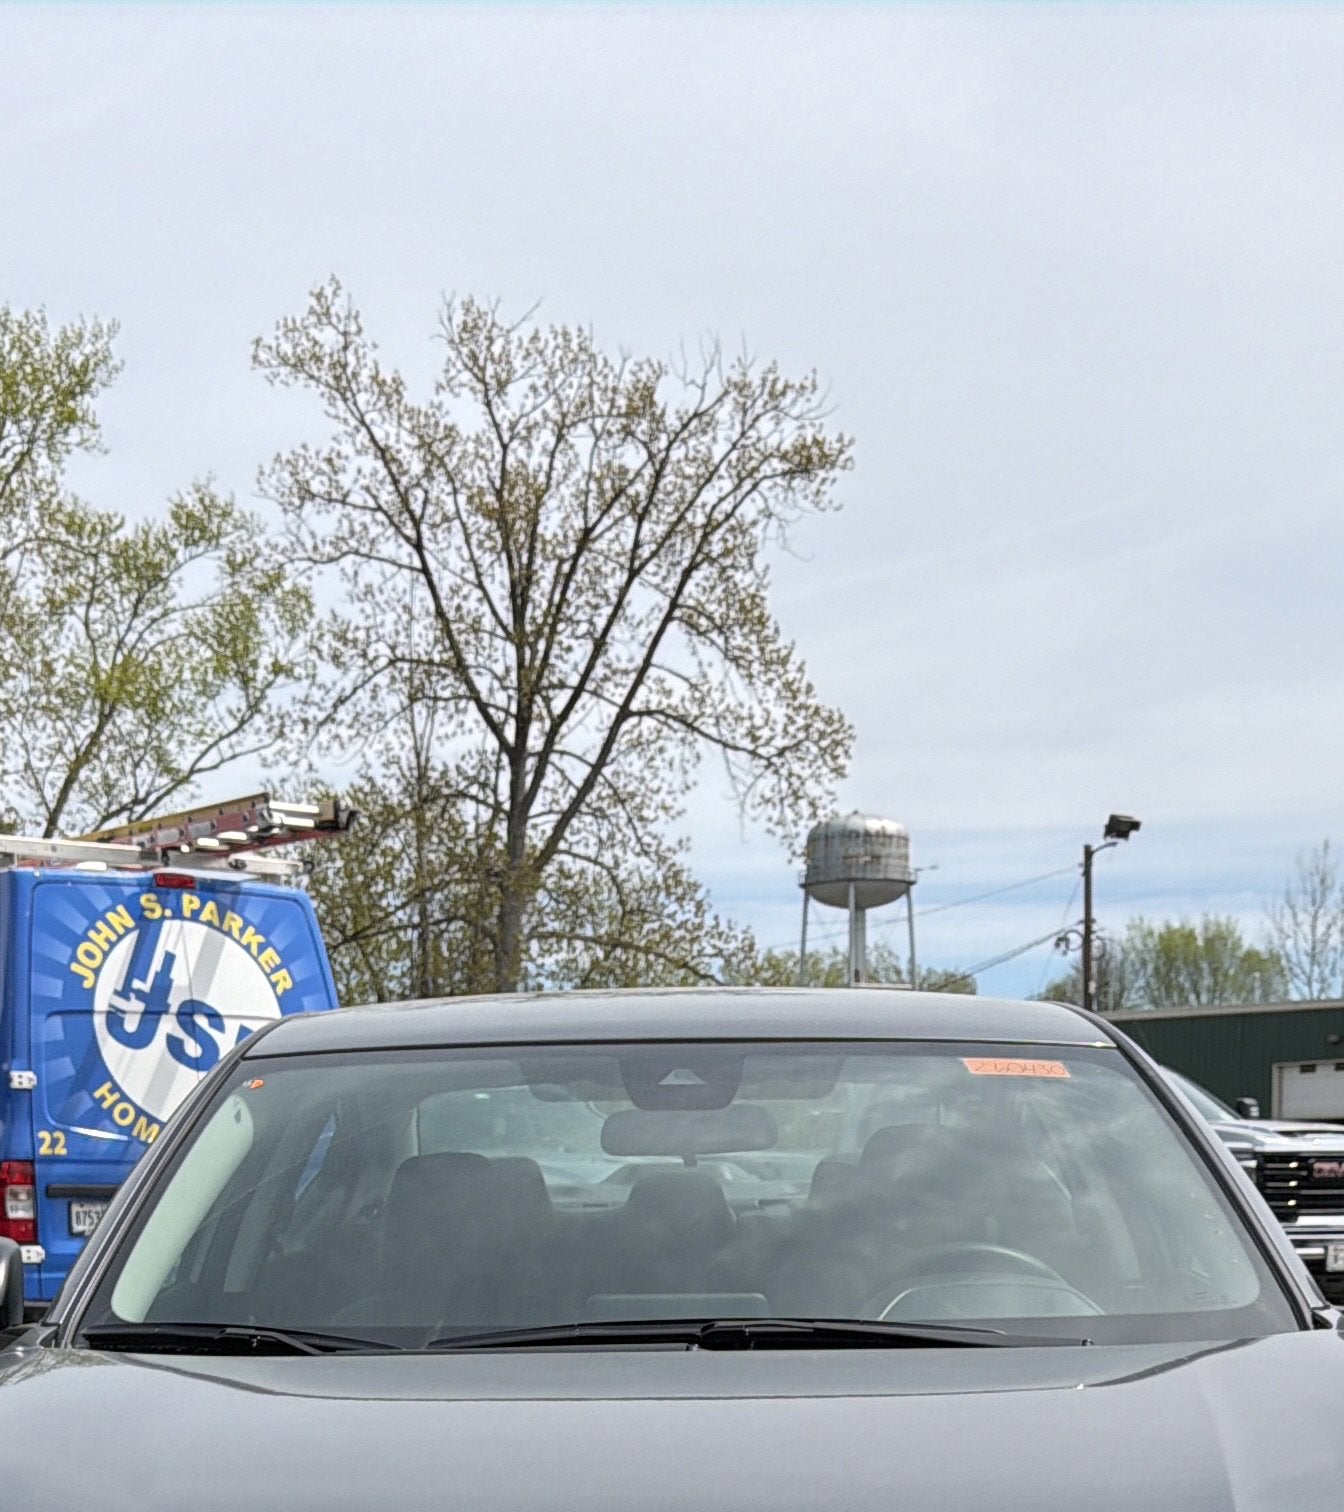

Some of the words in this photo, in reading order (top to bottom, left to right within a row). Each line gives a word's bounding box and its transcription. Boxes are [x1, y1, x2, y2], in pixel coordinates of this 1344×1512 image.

[70, 904, 136, 989] JOHN
[140, 893, 173, 919] S.
[182, 893, 293, 996] PARKER
[105, 940, 254, 1072] JS
[38, 1131, 68, 1156] 22
[93, 1081, 160, 1144] HOM
